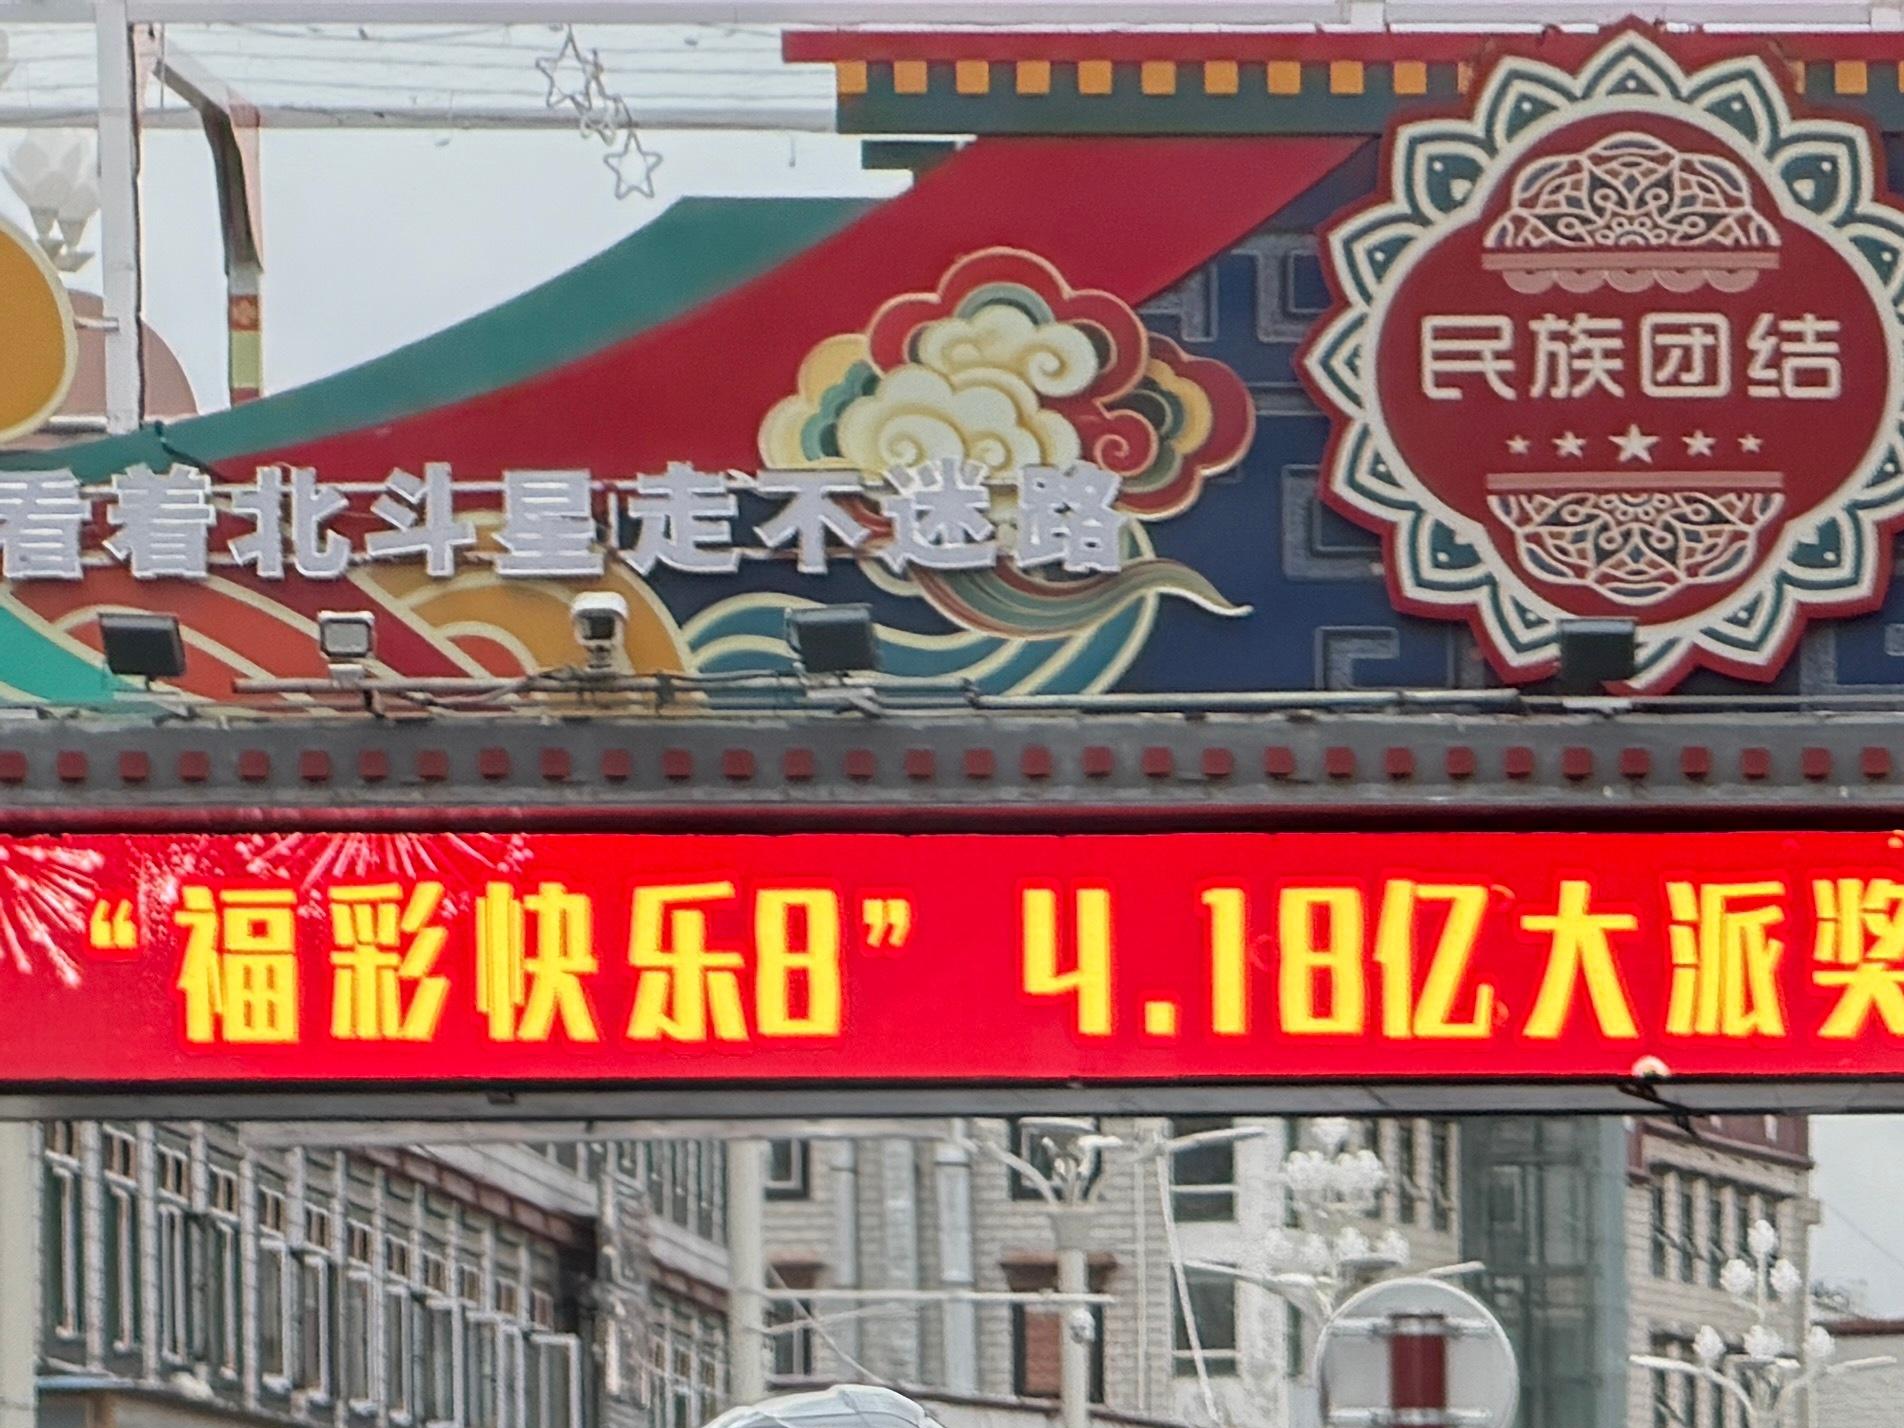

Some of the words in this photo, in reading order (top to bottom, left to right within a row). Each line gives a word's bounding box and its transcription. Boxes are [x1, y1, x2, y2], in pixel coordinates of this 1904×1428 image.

[1420, 312, 1842, 399] 民族团结
[0, 460, 1126, 580] 看着北斗星走不迷路
[88, 880, 912, 1045] “福彩快乐8”
